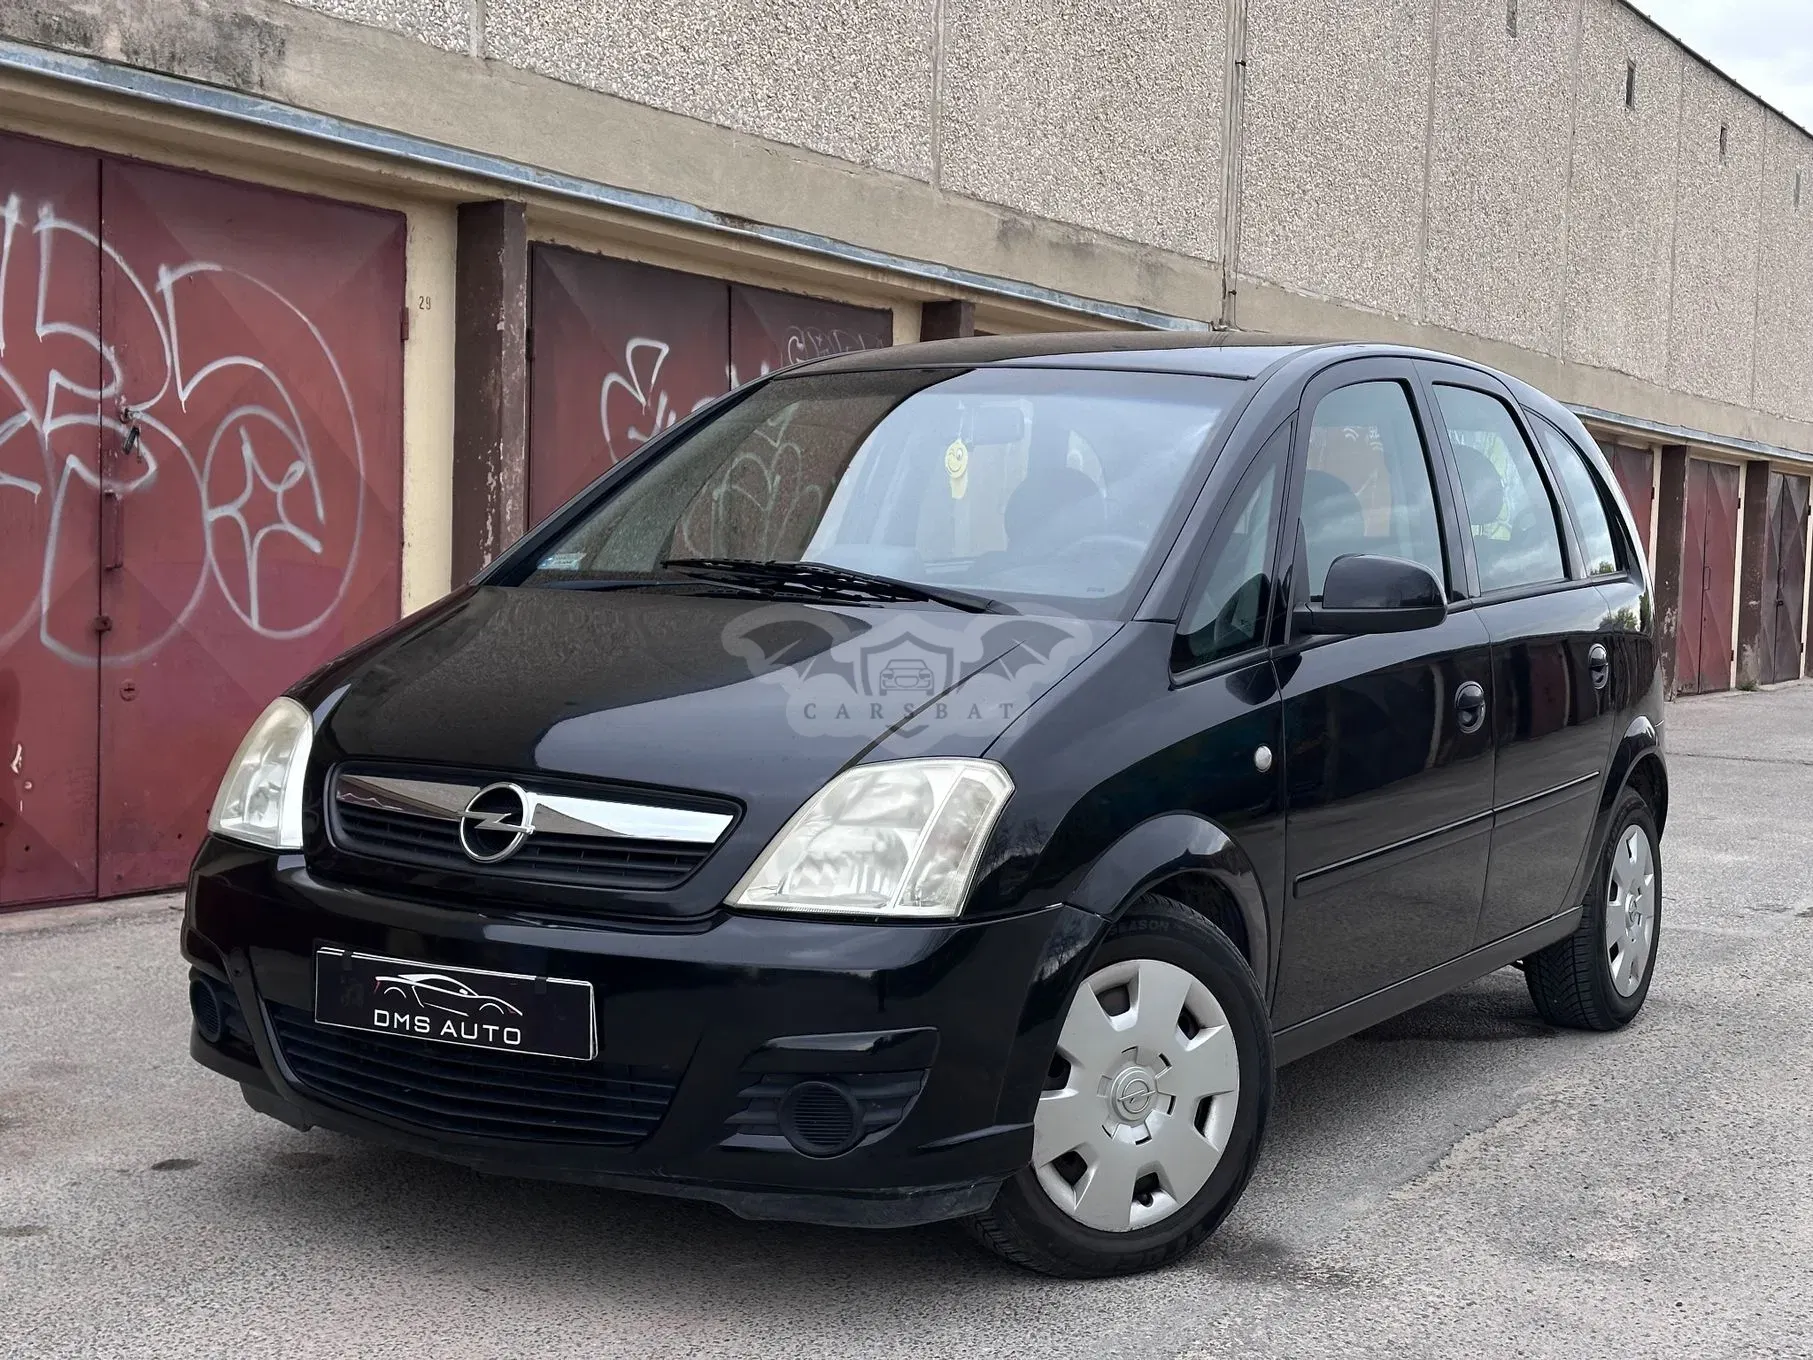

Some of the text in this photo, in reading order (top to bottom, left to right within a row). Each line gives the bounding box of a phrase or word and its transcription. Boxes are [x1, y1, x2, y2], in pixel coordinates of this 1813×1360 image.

[419, 296, 432, 310] 29
[373, 1009, 523, 1045] DMS AUTO
